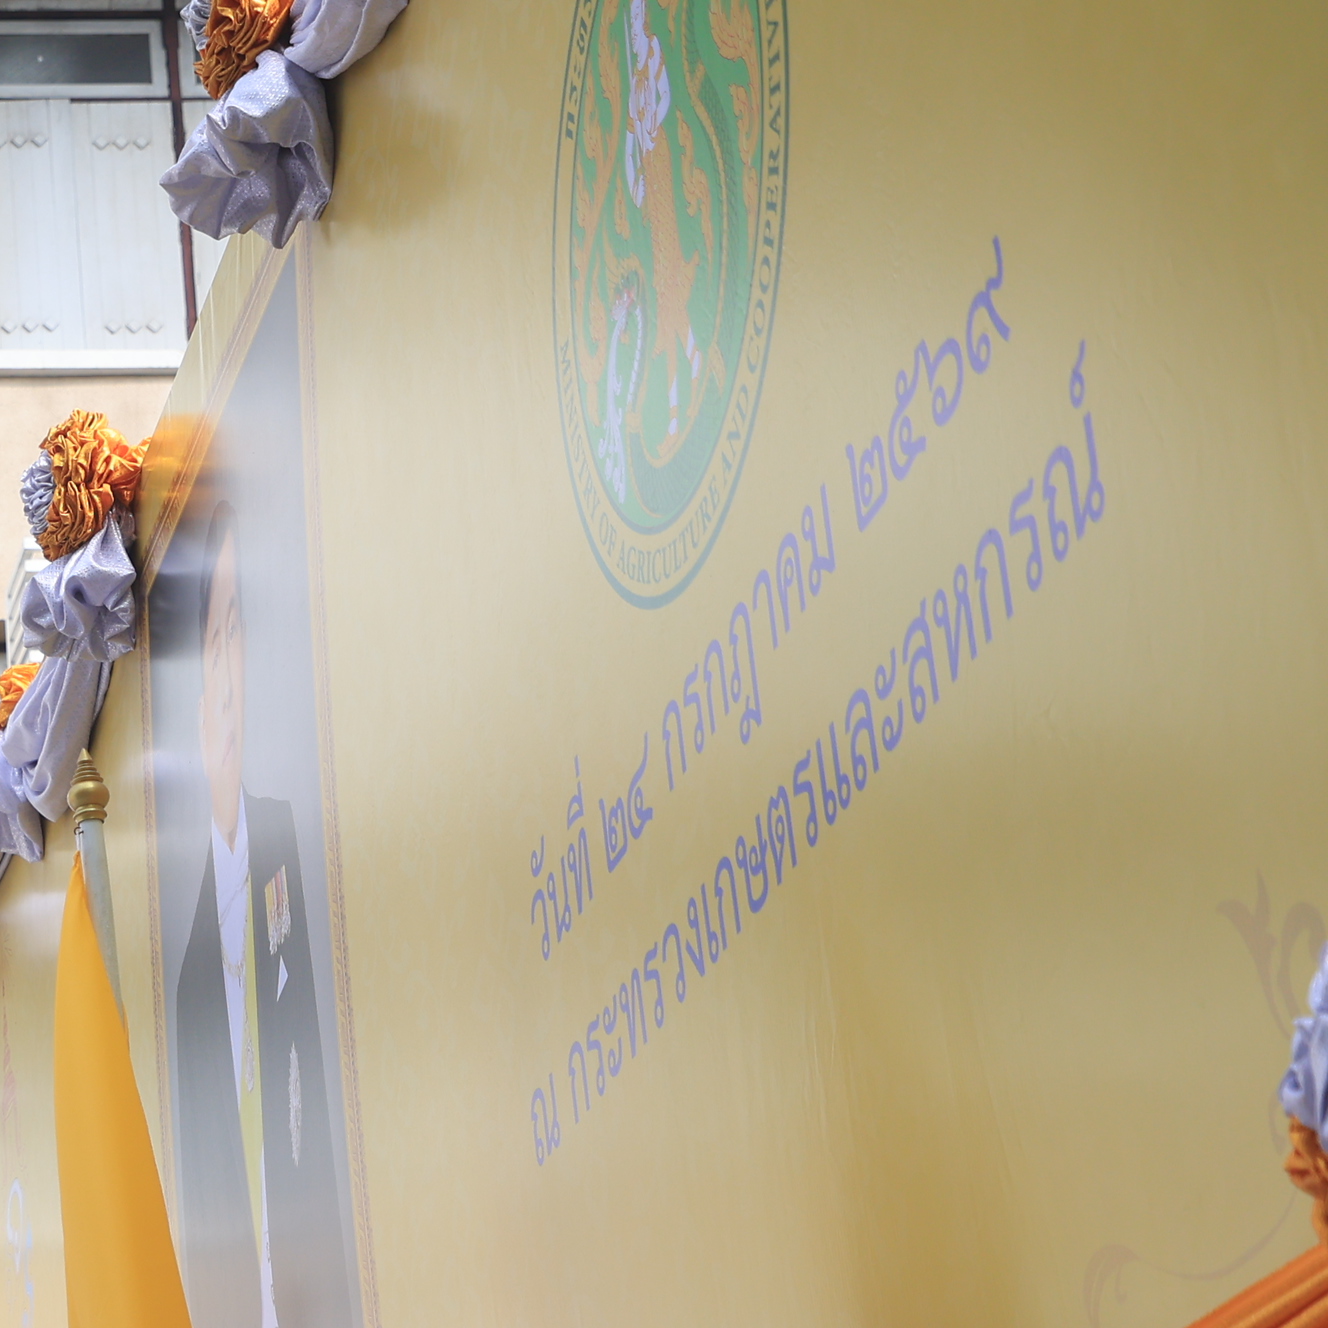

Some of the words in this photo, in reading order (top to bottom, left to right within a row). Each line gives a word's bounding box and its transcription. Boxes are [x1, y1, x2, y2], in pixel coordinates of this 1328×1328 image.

[530, 755, 595, 961] วันที่
[598, 732, 654, 873] ๒๔
[661, 483, 836, 792] กรกฎาคม
[845, 234, 1012, 533] ๒๕๖๙
[530, 1073, 561, 1166] ณ
[567, 338, 1106, 1125] กระทรวงเกษตรและสหกรณ์
[560, 339, 601, 519] MINISTRY
[598, 511, 618, 558] OF
[616, 475, 721, 585] AGRICULTURE
[721, 383, 750, 487] AND
